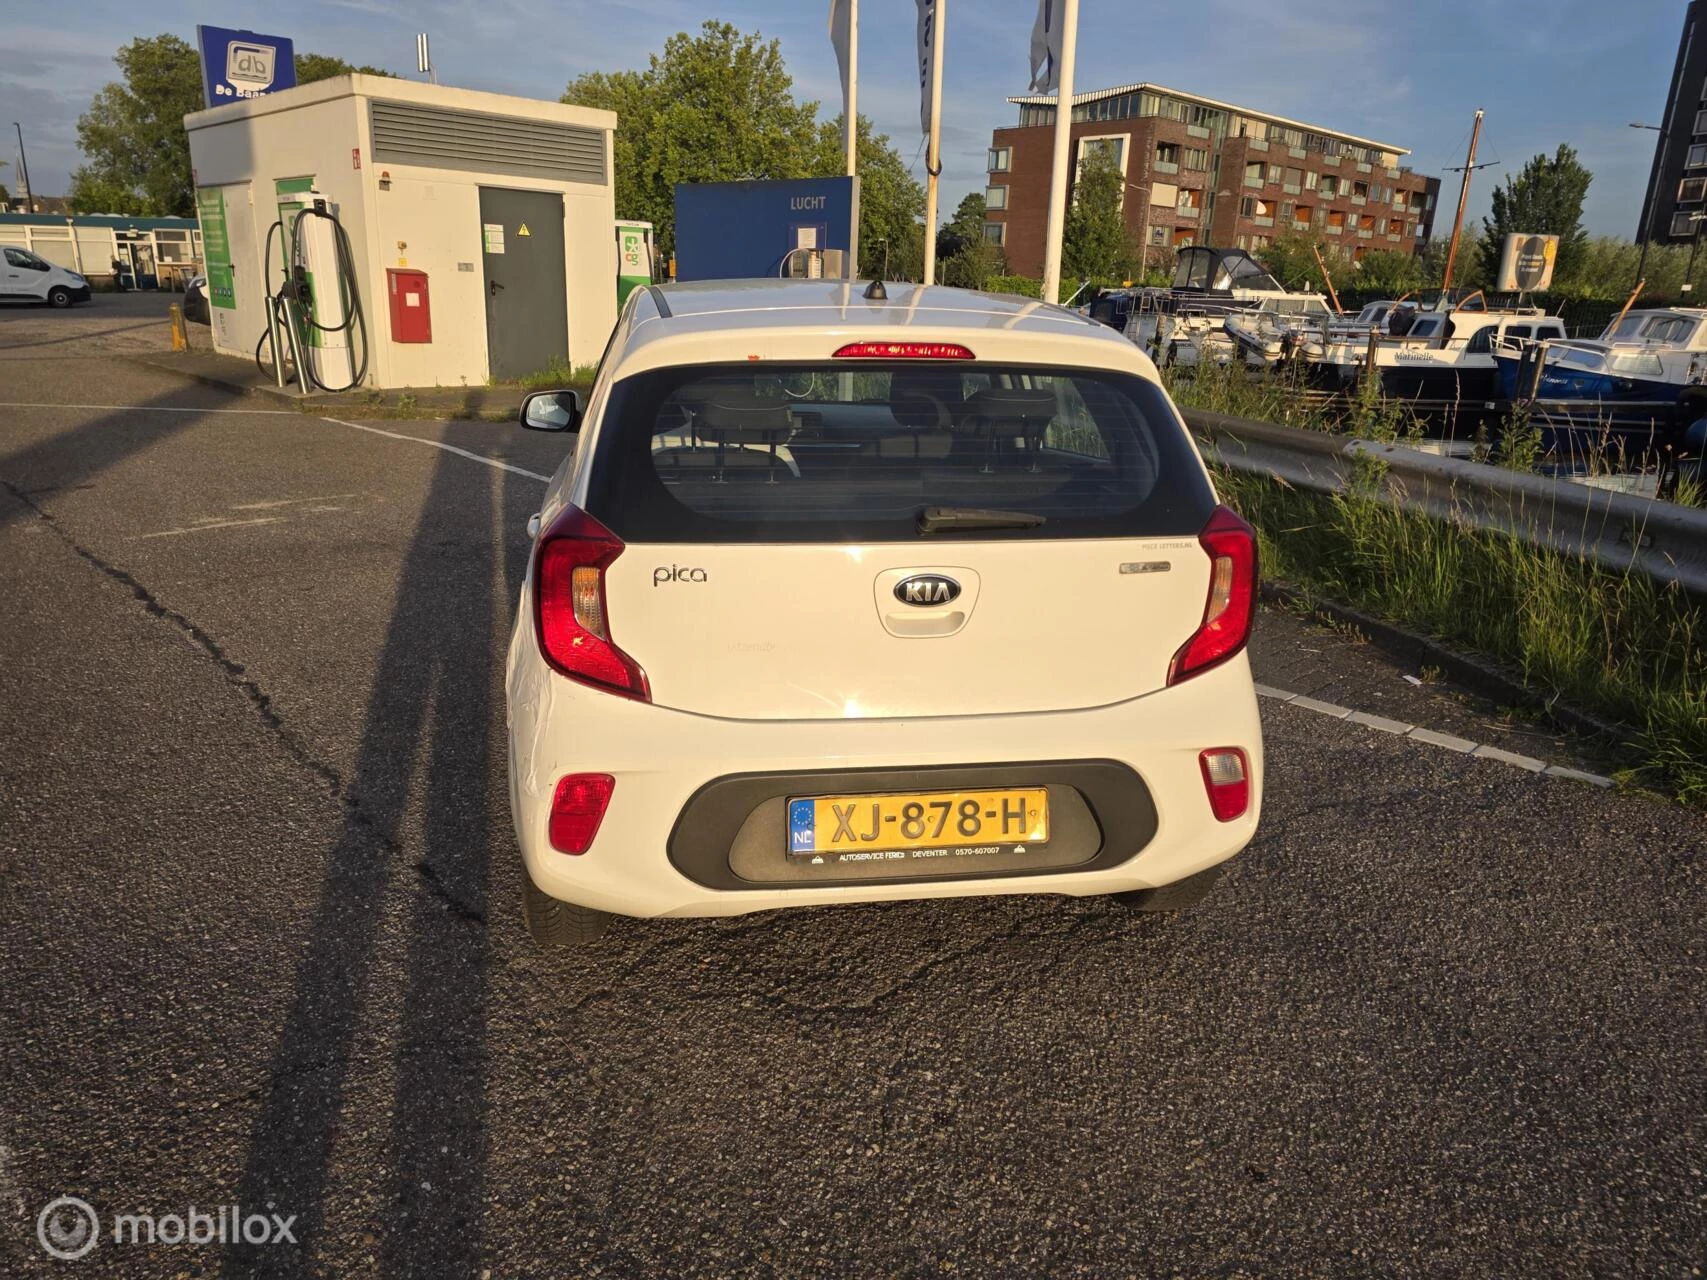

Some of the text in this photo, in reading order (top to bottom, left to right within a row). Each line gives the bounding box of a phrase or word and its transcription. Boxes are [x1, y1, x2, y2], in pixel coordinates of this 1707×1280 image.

[215, 84, 232, 96] De
[790, 196, 826, 210] LUCHT
[653, 563, 708, 587] pica
[905, 582, 951, 602] KIA
[831, 797, 1027, 843] XJ-878-H
[794, 832, 812, 845] NL
[839, 852, 884, 861] AUTOSERVICE
[912, 849, 948, 858] DEVENTER
[955, 846, 1000, 856] 0570-607007
